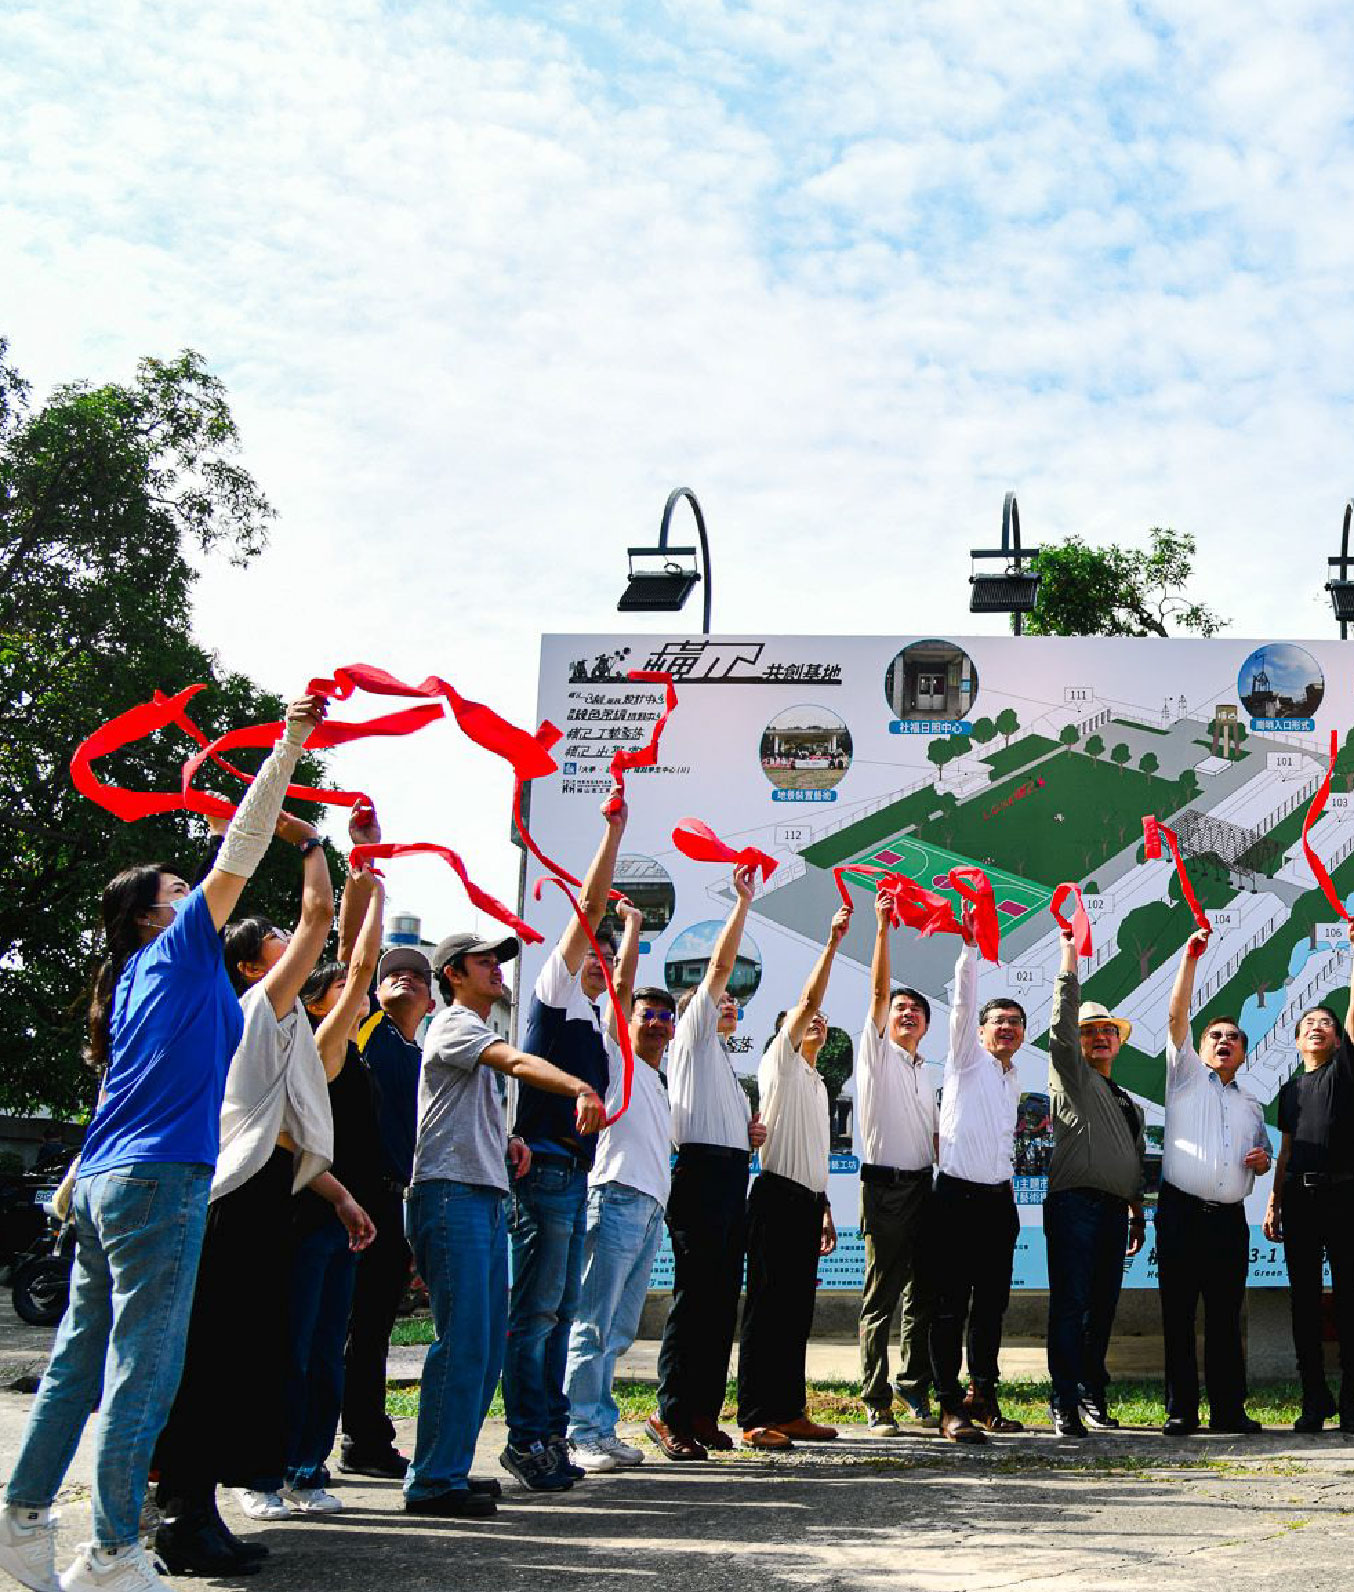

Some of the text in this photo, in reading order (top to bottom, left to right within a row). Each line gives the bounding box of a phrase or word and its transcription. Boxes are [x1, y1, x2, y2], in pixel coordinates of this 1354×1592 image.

[1071, 690, 1086, 700] 111
[900, 722, 962, 734] 社福日照中心
[1277, 757, 1292, 766] 101
[1332, 798, 1348, 808] 103
[784, 830, 802, 840] 112
[1087, 899, 1103, 909] 102
[1214, 914, 1231, 924] 104
[1016, 971, 1033, 982] 021
[1254, 1269, 1283, 1278] Green
